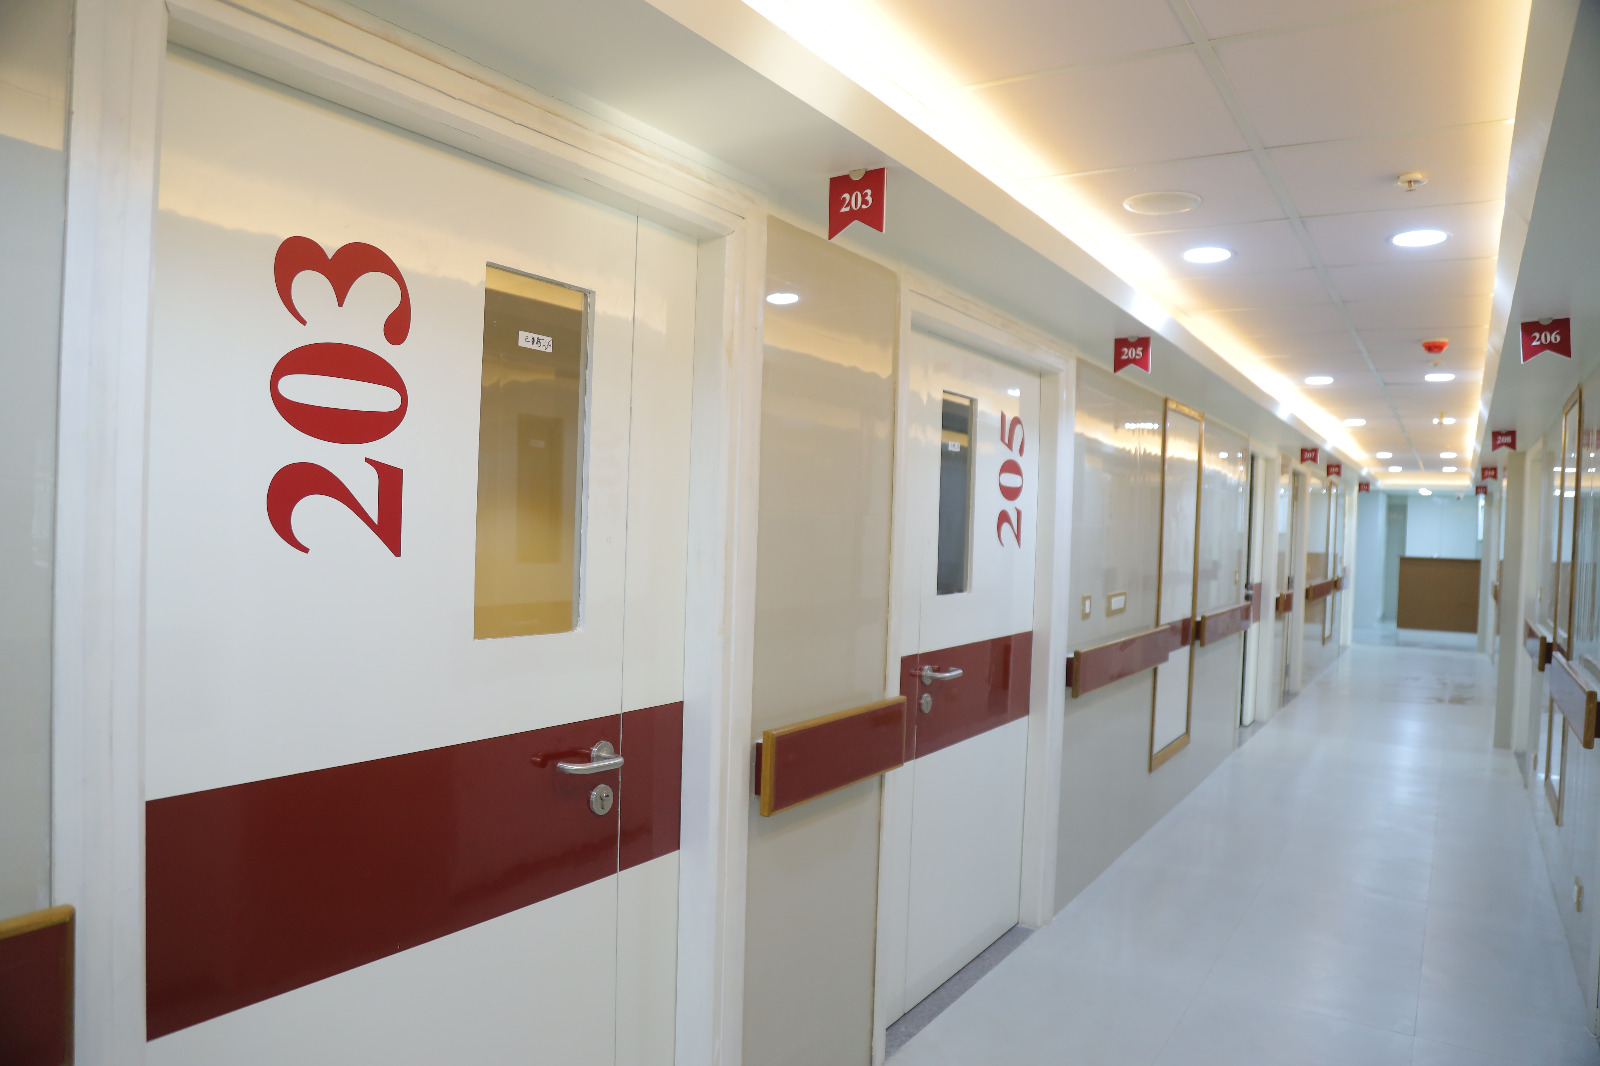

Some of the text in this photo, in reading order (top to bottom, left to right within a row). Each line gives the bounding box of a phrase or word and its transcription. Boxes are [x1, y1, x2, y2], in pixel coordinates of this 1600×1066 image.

[840, 188, 873, 212] 203
[1531, 330, 1561, 346] 206
[1121, 347, 1143, 360] 205
[266, 235, 411, 557] 203
[997, 409, 1025, 549] 205
